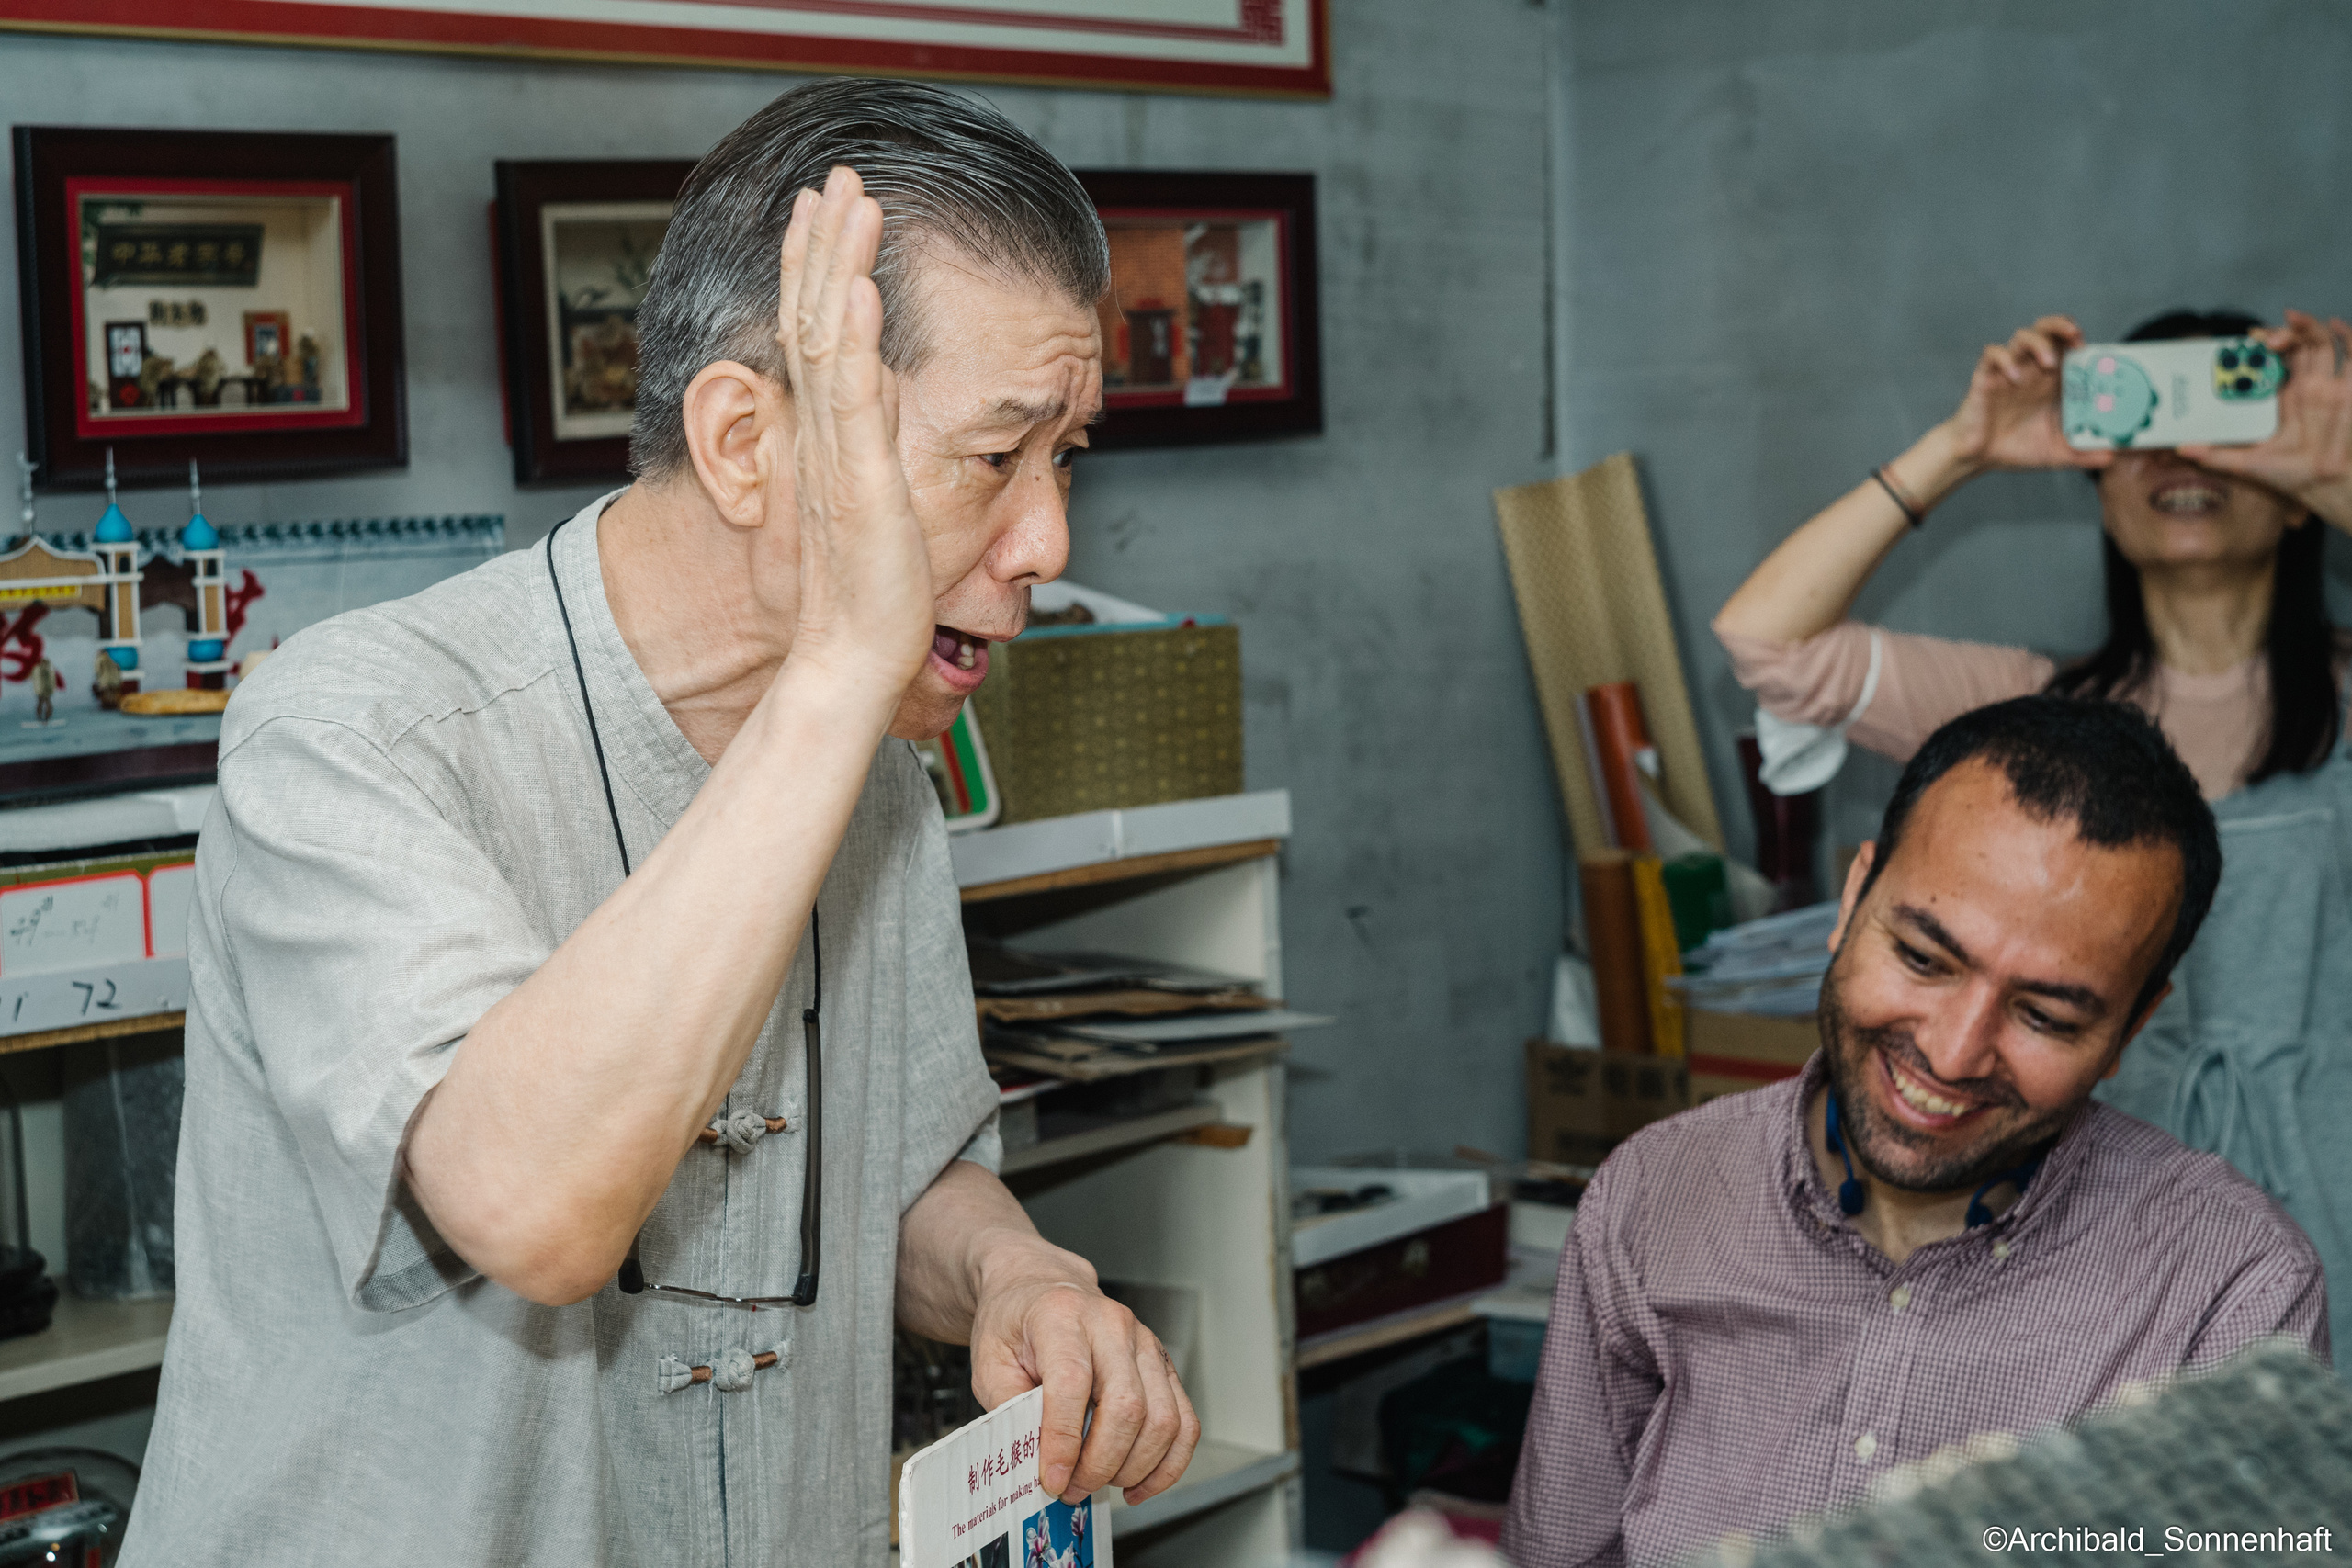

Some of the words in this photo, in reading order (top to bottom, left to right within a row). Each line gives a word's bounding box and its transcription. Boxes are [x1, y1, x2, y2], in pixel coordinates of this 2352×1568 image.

[72, 977, 121, 1017] 72
[952, 1523, 966, 1540] The
[967, 1502, 997, 1531] materials
[998, 1496, 1009, 1511] for
[1010, 1483, 1033, 1505] making
